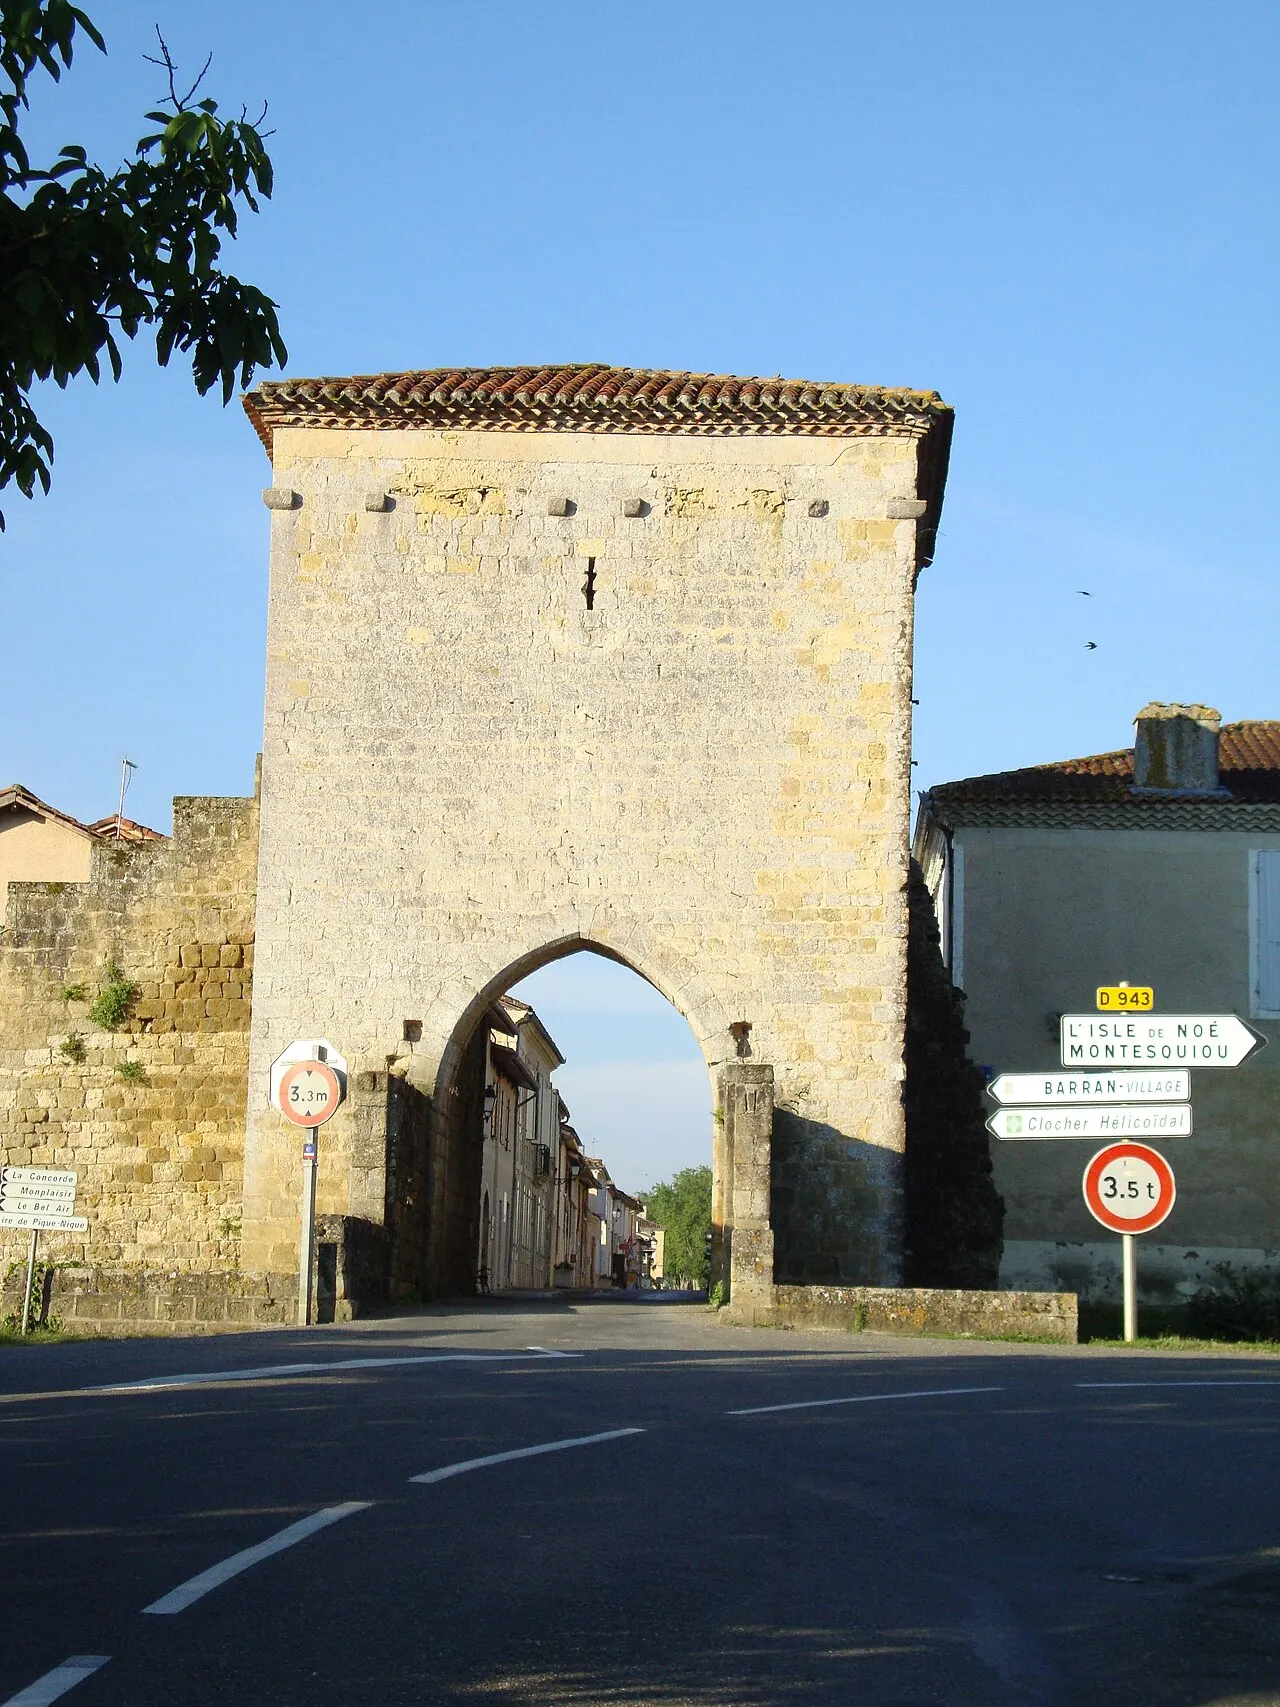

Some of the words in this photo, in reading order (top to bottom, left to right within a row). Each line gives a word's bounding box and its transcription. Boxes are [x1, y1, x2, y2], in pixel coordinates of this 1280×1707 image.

[1100, 992, 1110, 1006] D
[1118, 991, 1150, 1006] 943
[1069, 1023, 1137, 1038] L'ISLE
[1177, 1021, 1219, 1038] NOÉ
[1070, 1044, 1228, 1059] MONTESQUIOU
[1028, 1116, 1089, 1132] Clocher
[1100, 1112, 1184, 1130] Hélicoïdal
[12, 1171, 22, 1180] La
[29, 1172, 74, 1183] Concorde
[20, 1186, 72, 1197] Monplaisir
[17, 1202, 27, 1210] Le
[33, 1202, 50, 1212] Bel
[55, 1205, 70, 1213] Air
[17, 1217, 28, 1226] de
